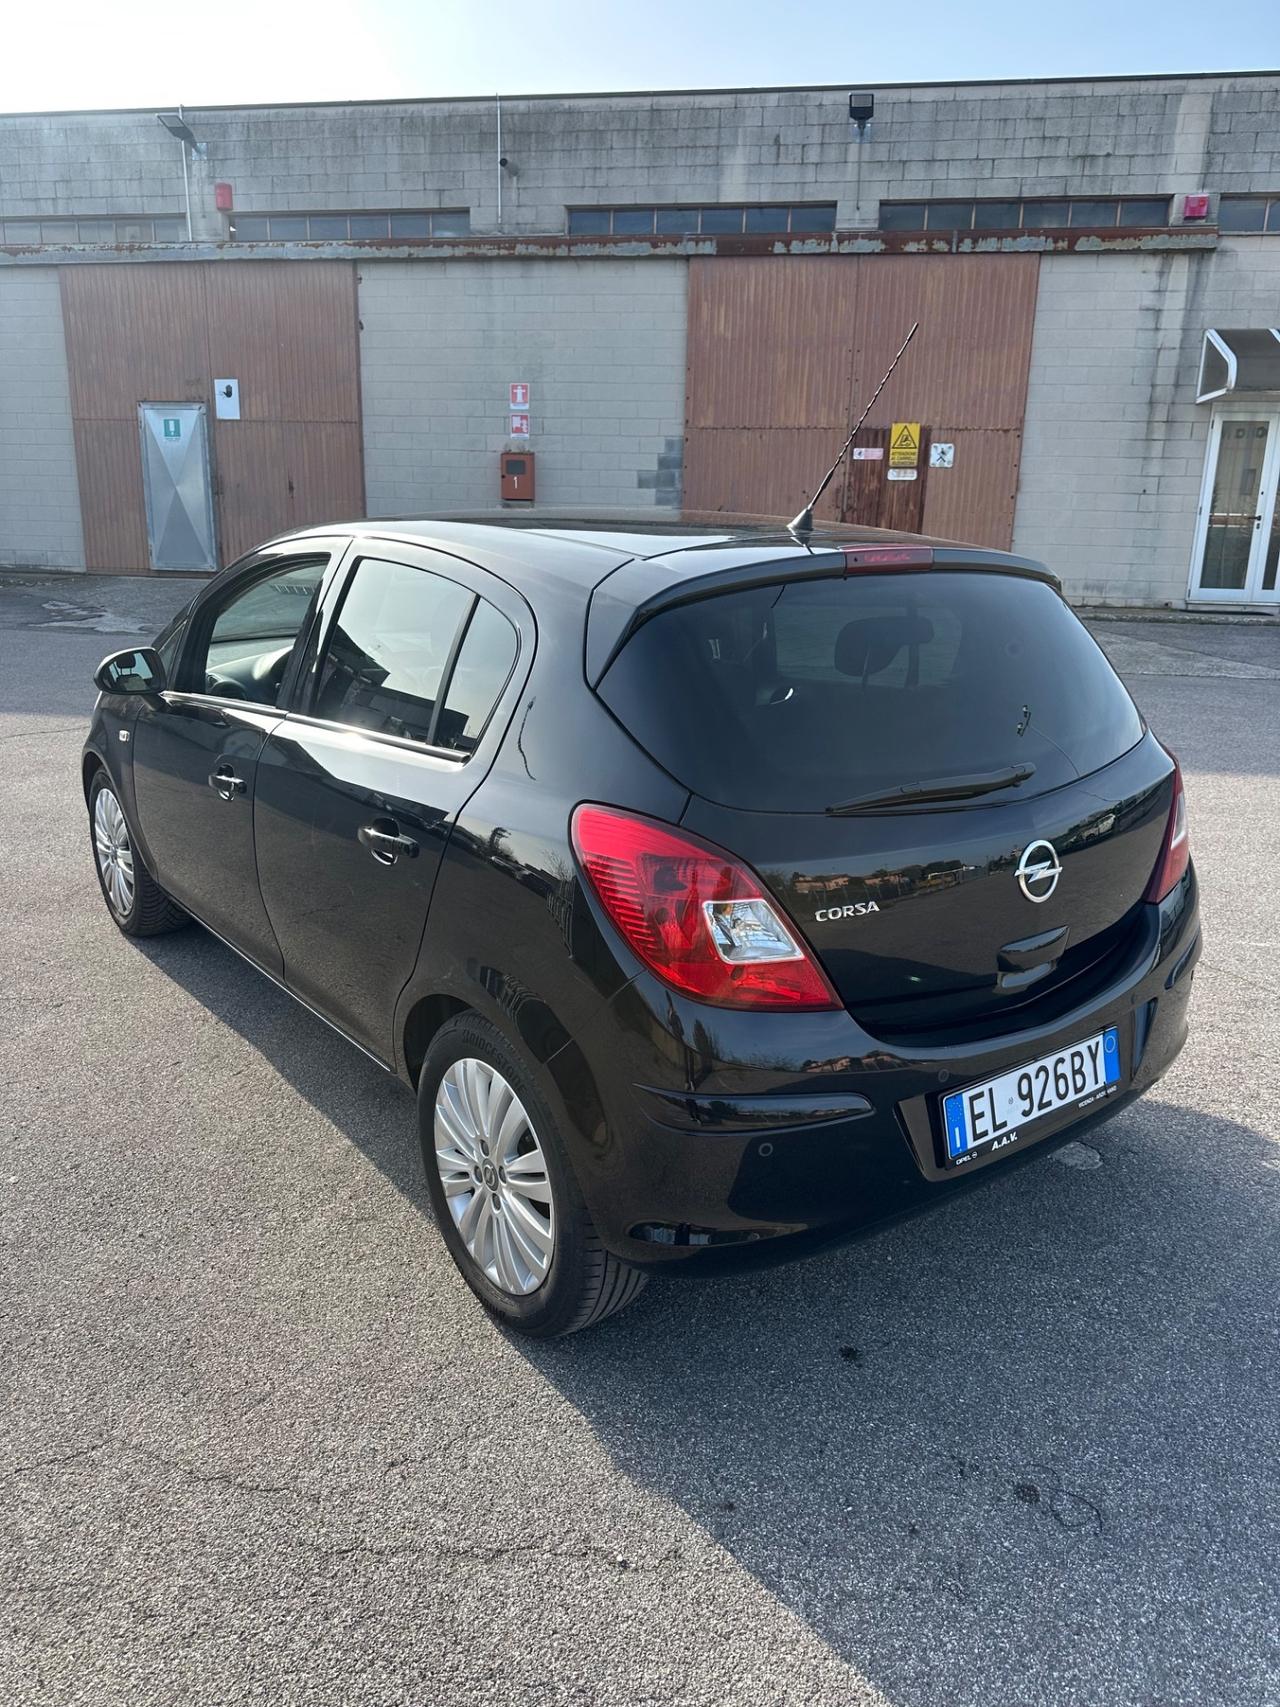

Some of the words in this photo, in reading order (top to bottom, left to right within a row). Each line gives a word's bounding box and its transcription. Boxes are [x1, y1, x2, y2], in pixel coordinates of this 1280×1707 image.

[815, 901, 880, 922] CORSA
[968, 1087, 1008, 1142] EL
[1017, 1041, 1100, 1118] 926BY
[991, 1131, 1018, 1151] A.A.V.
[956, 1154, 972, 1166] OPEL
